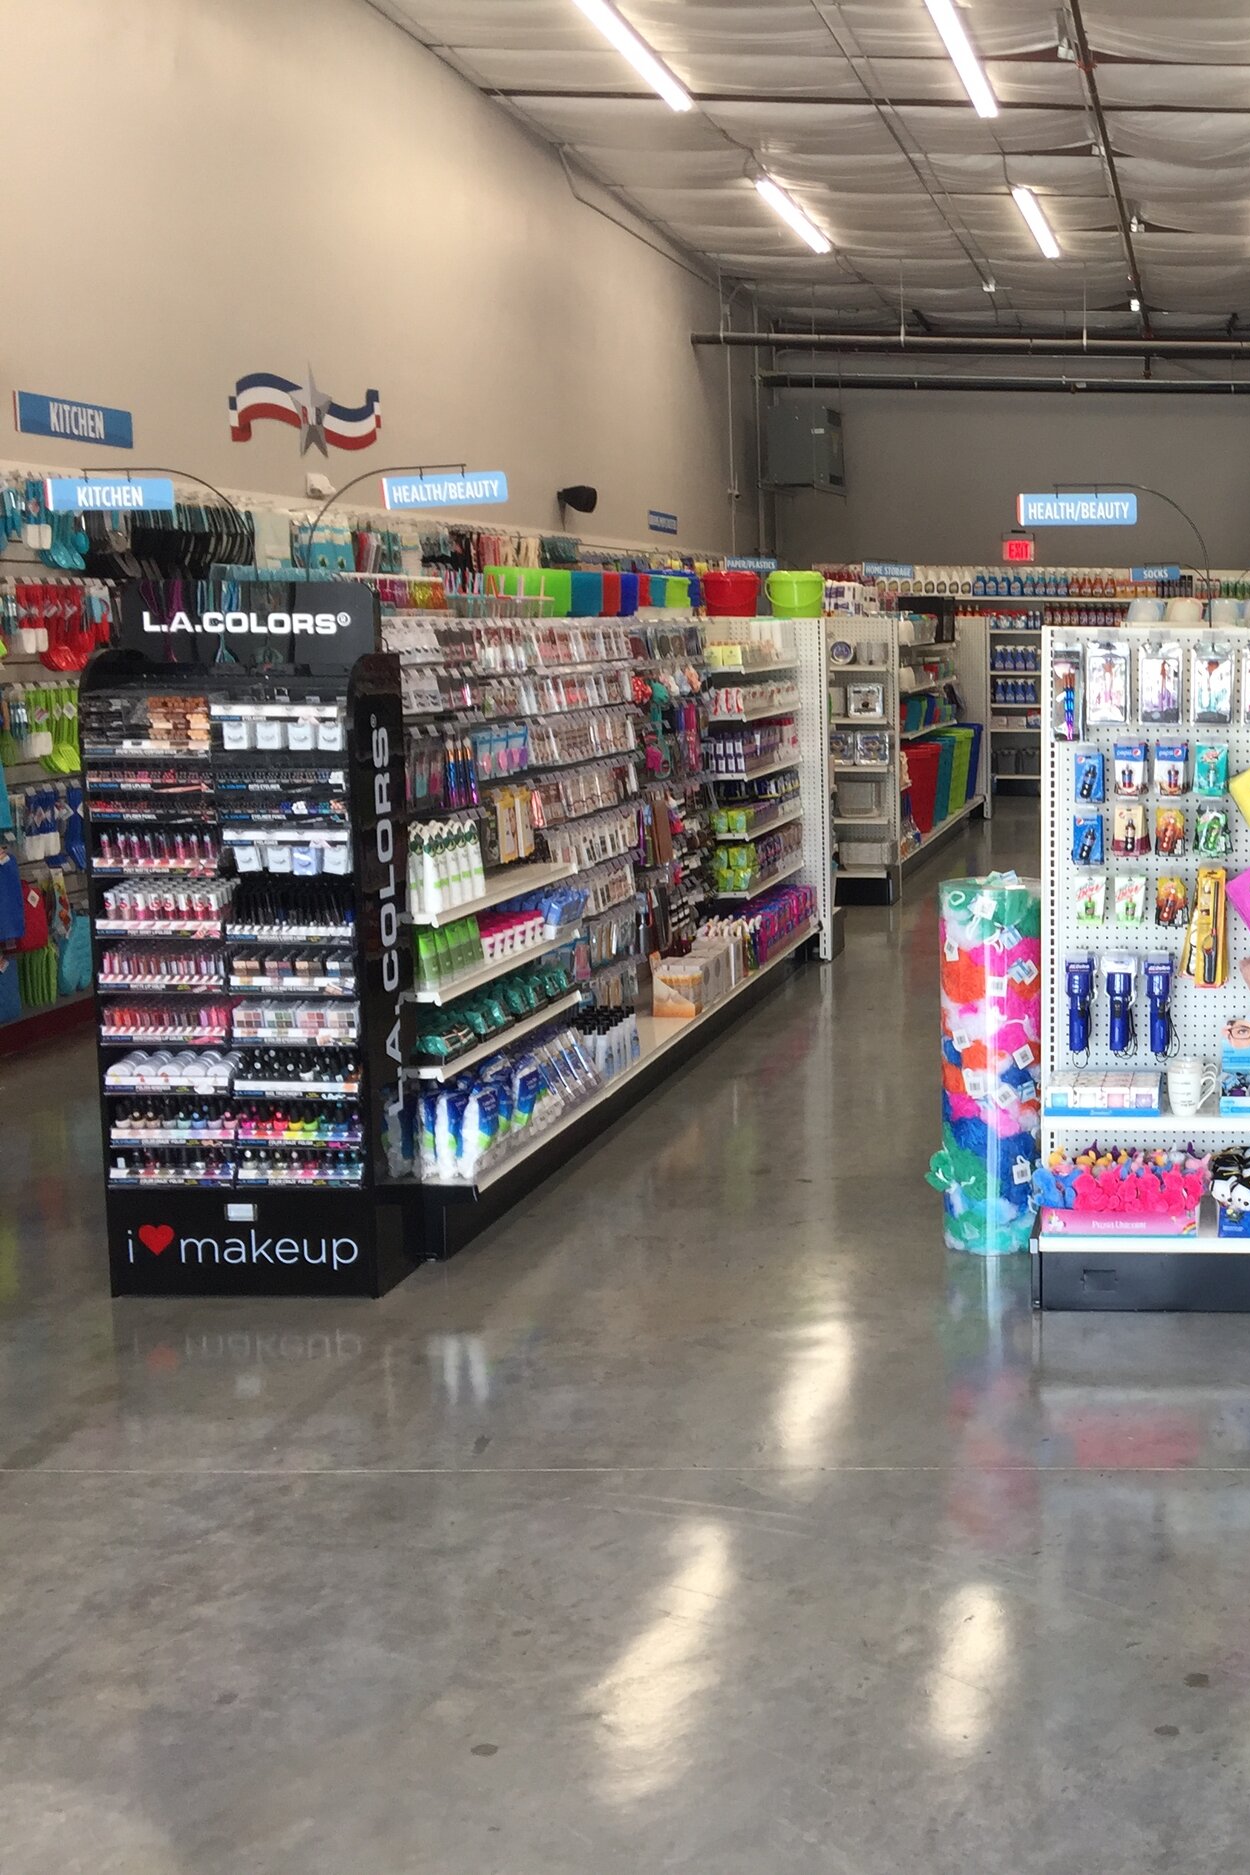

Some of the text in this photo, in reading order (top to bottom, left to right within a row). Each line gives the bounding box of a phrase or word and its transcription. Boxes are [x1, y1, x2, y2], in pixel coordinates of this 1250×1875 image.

[50, 402, 105, 439] KITCHEN
[77, 485, 144, 507] KITCHEN
[392, 479, 499, 504] HEALTH/BEAUTY
[1028, 501, 1130, 521] HEALTH/BEAUTY
[1008, 542, 1030, 559] EXIT
[726, 559, 776, 569] PAPER/PLASTICS
[865, 565, 912, 577] HOME STORAGE
[1143, 569, 1169, 579] SOCKS
[127, 1229, 359, 1271] i makeup
